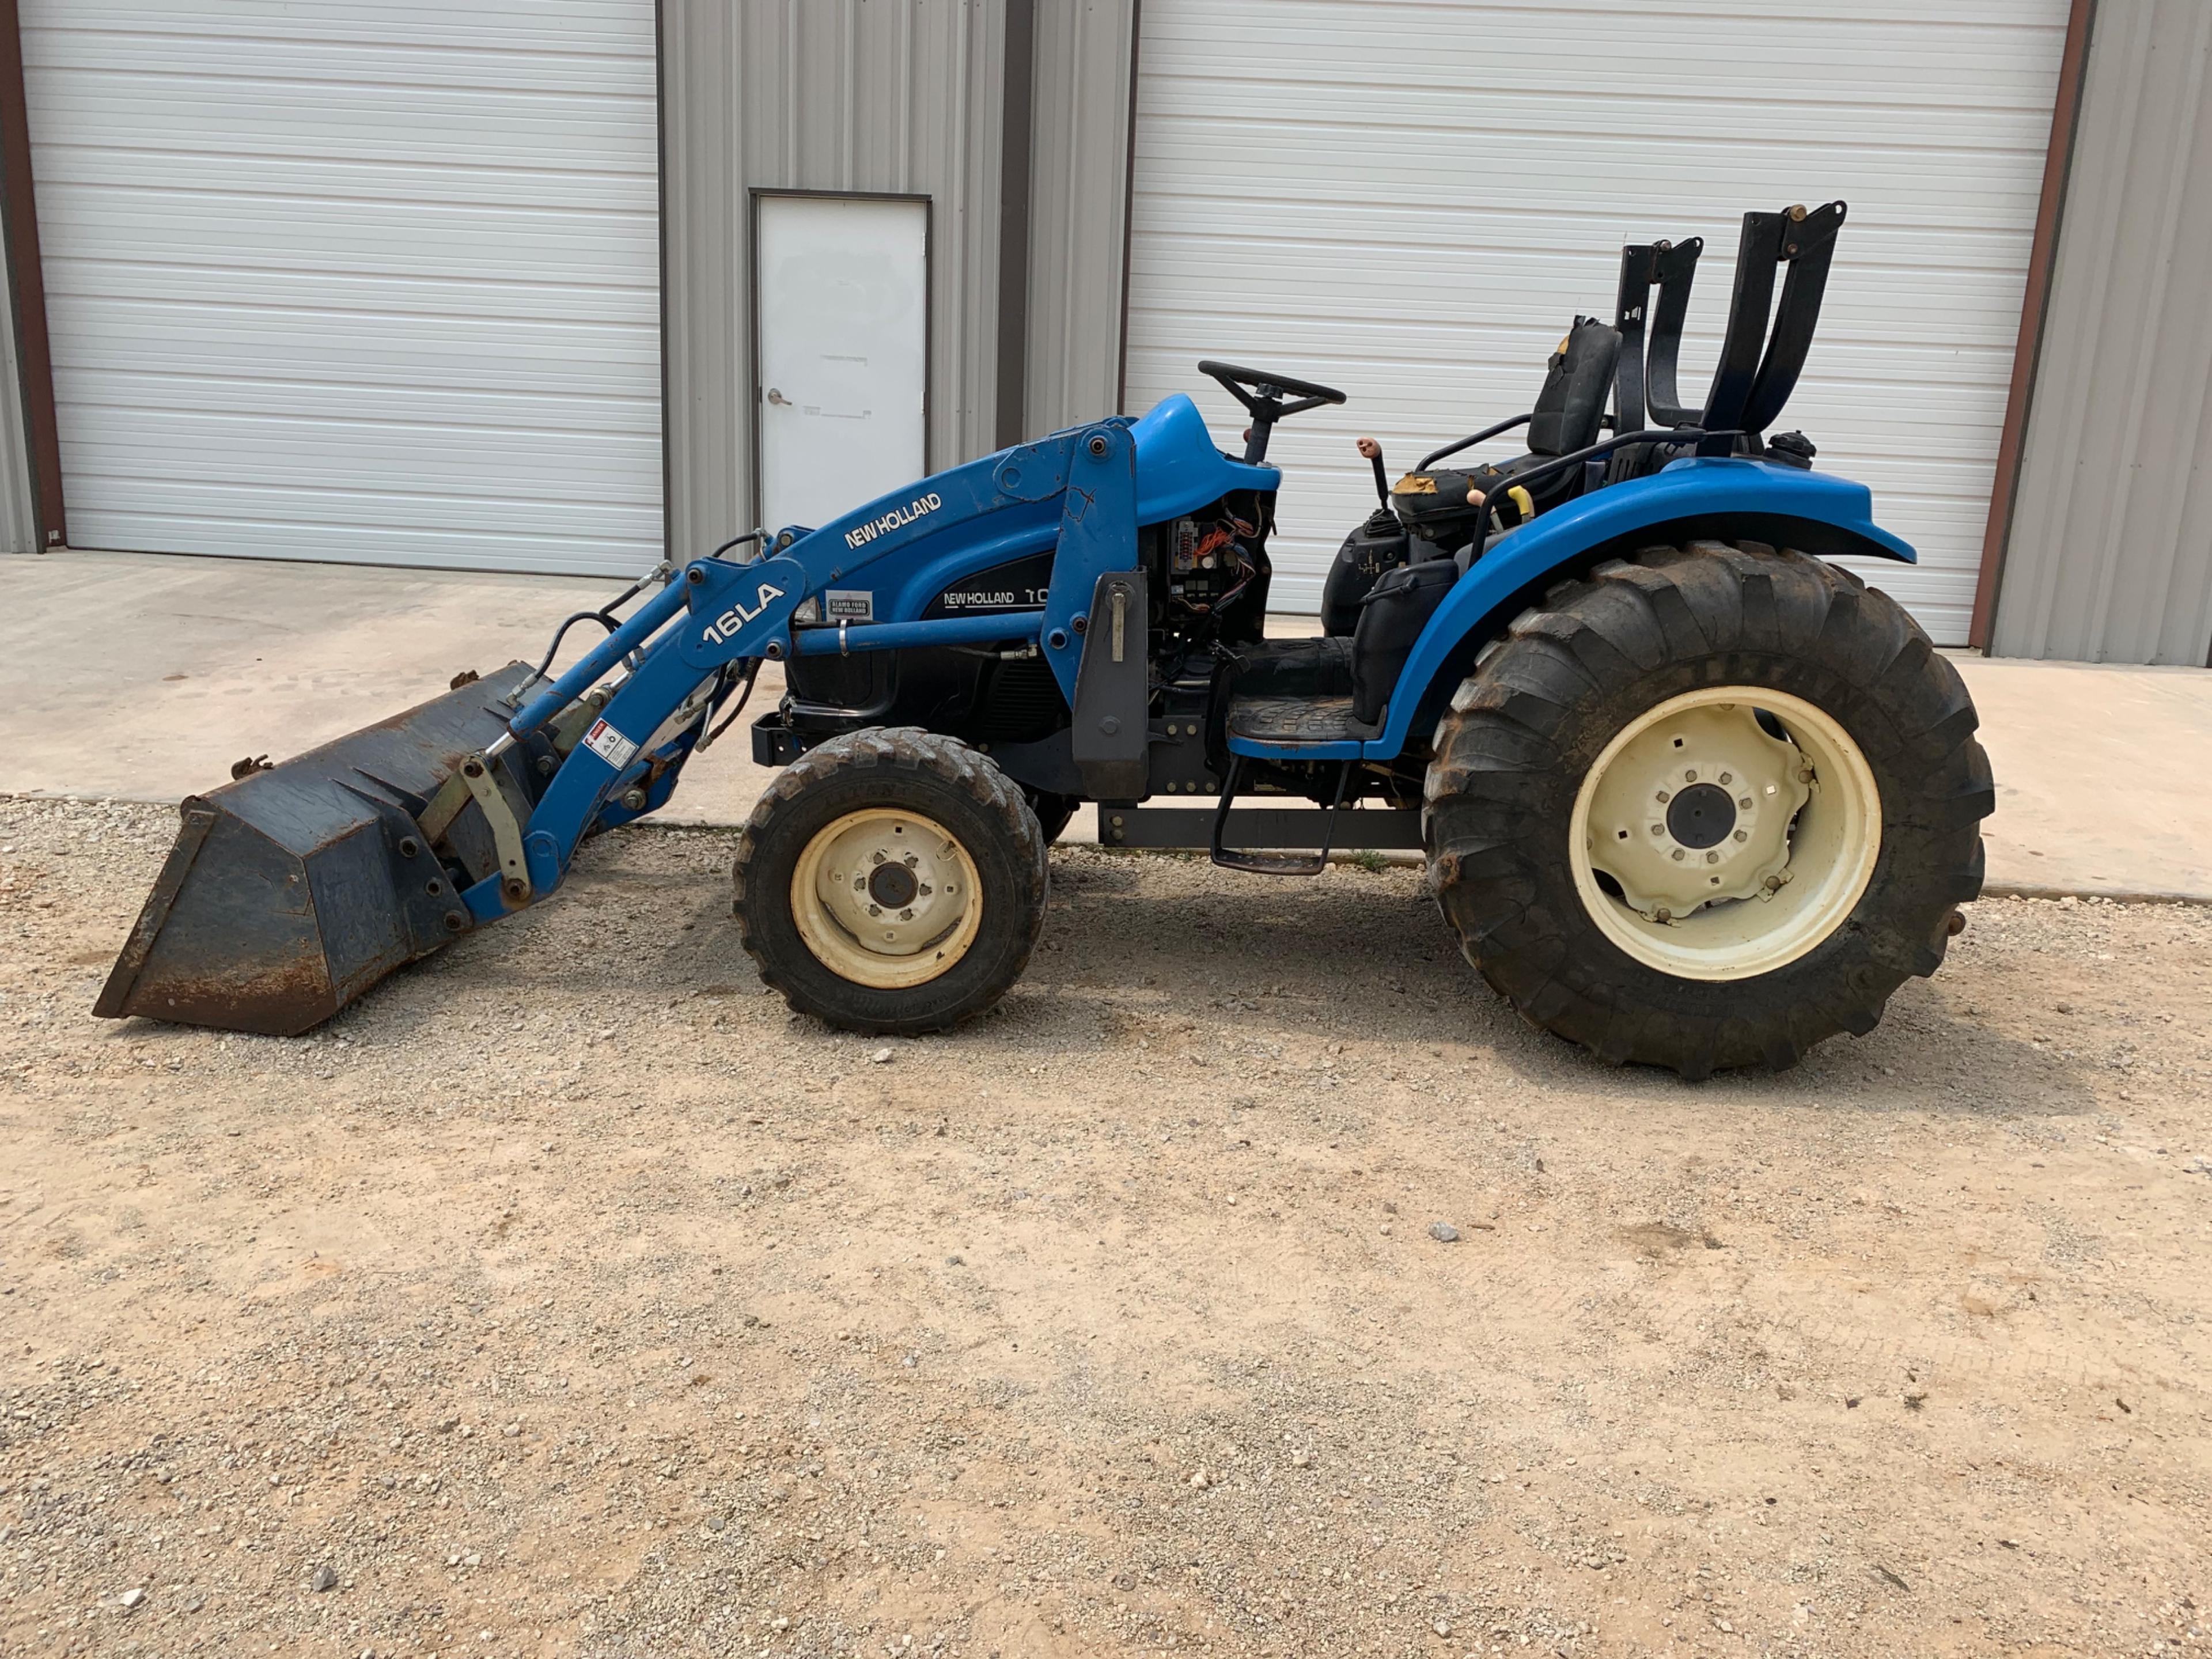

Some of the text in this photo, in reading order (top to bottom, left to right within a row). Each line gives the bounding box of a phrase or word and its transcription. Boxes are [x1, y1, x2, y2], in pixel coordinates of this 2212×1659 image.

[844, 493, 942, 550] NEW HOLLAND
[703, 583, 785, 645] 16LA
[944, 593, 966, 604] NEW
[967, 592, 1014, 604] HOLLAND
